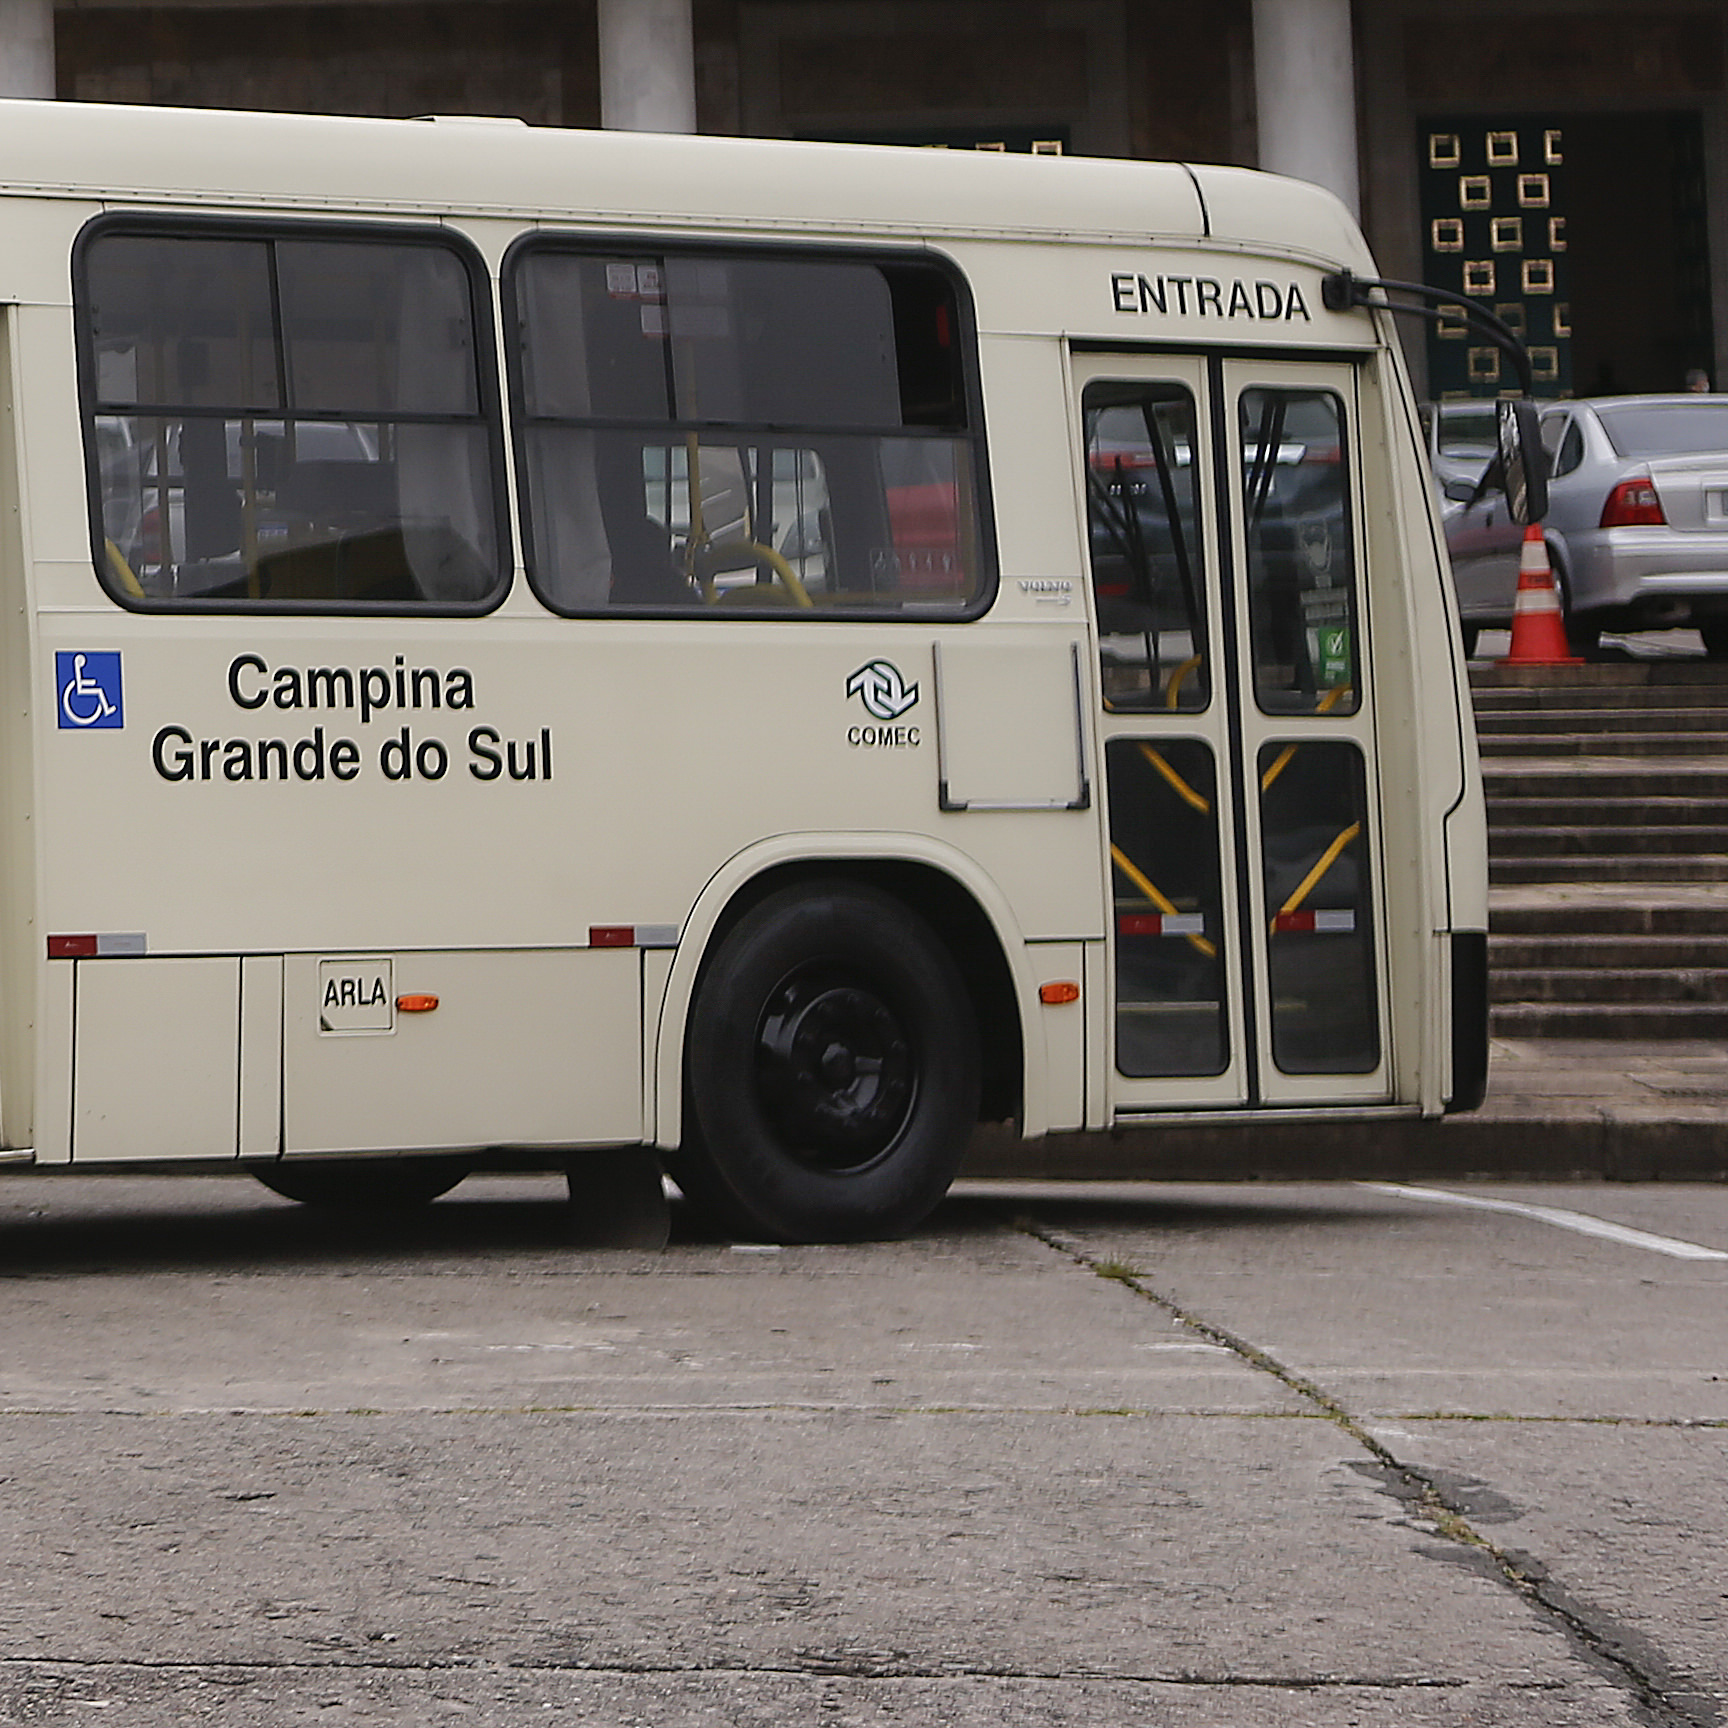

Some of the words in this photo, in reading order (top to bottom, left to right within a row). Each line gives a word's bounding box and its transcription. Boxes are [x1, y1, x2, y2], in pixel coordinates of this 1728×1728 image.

[1111, 274, 1312, 322] ENTRADA
[228, 654, 475, 724] Campina
[152, 725, 360, 782] Grande
[380, 726, 448, 781] do
[468, 727, 552, 781] Sul
[847, 726, 921, 747] COMEC
[324, 977, 387, 1008] ARLA
